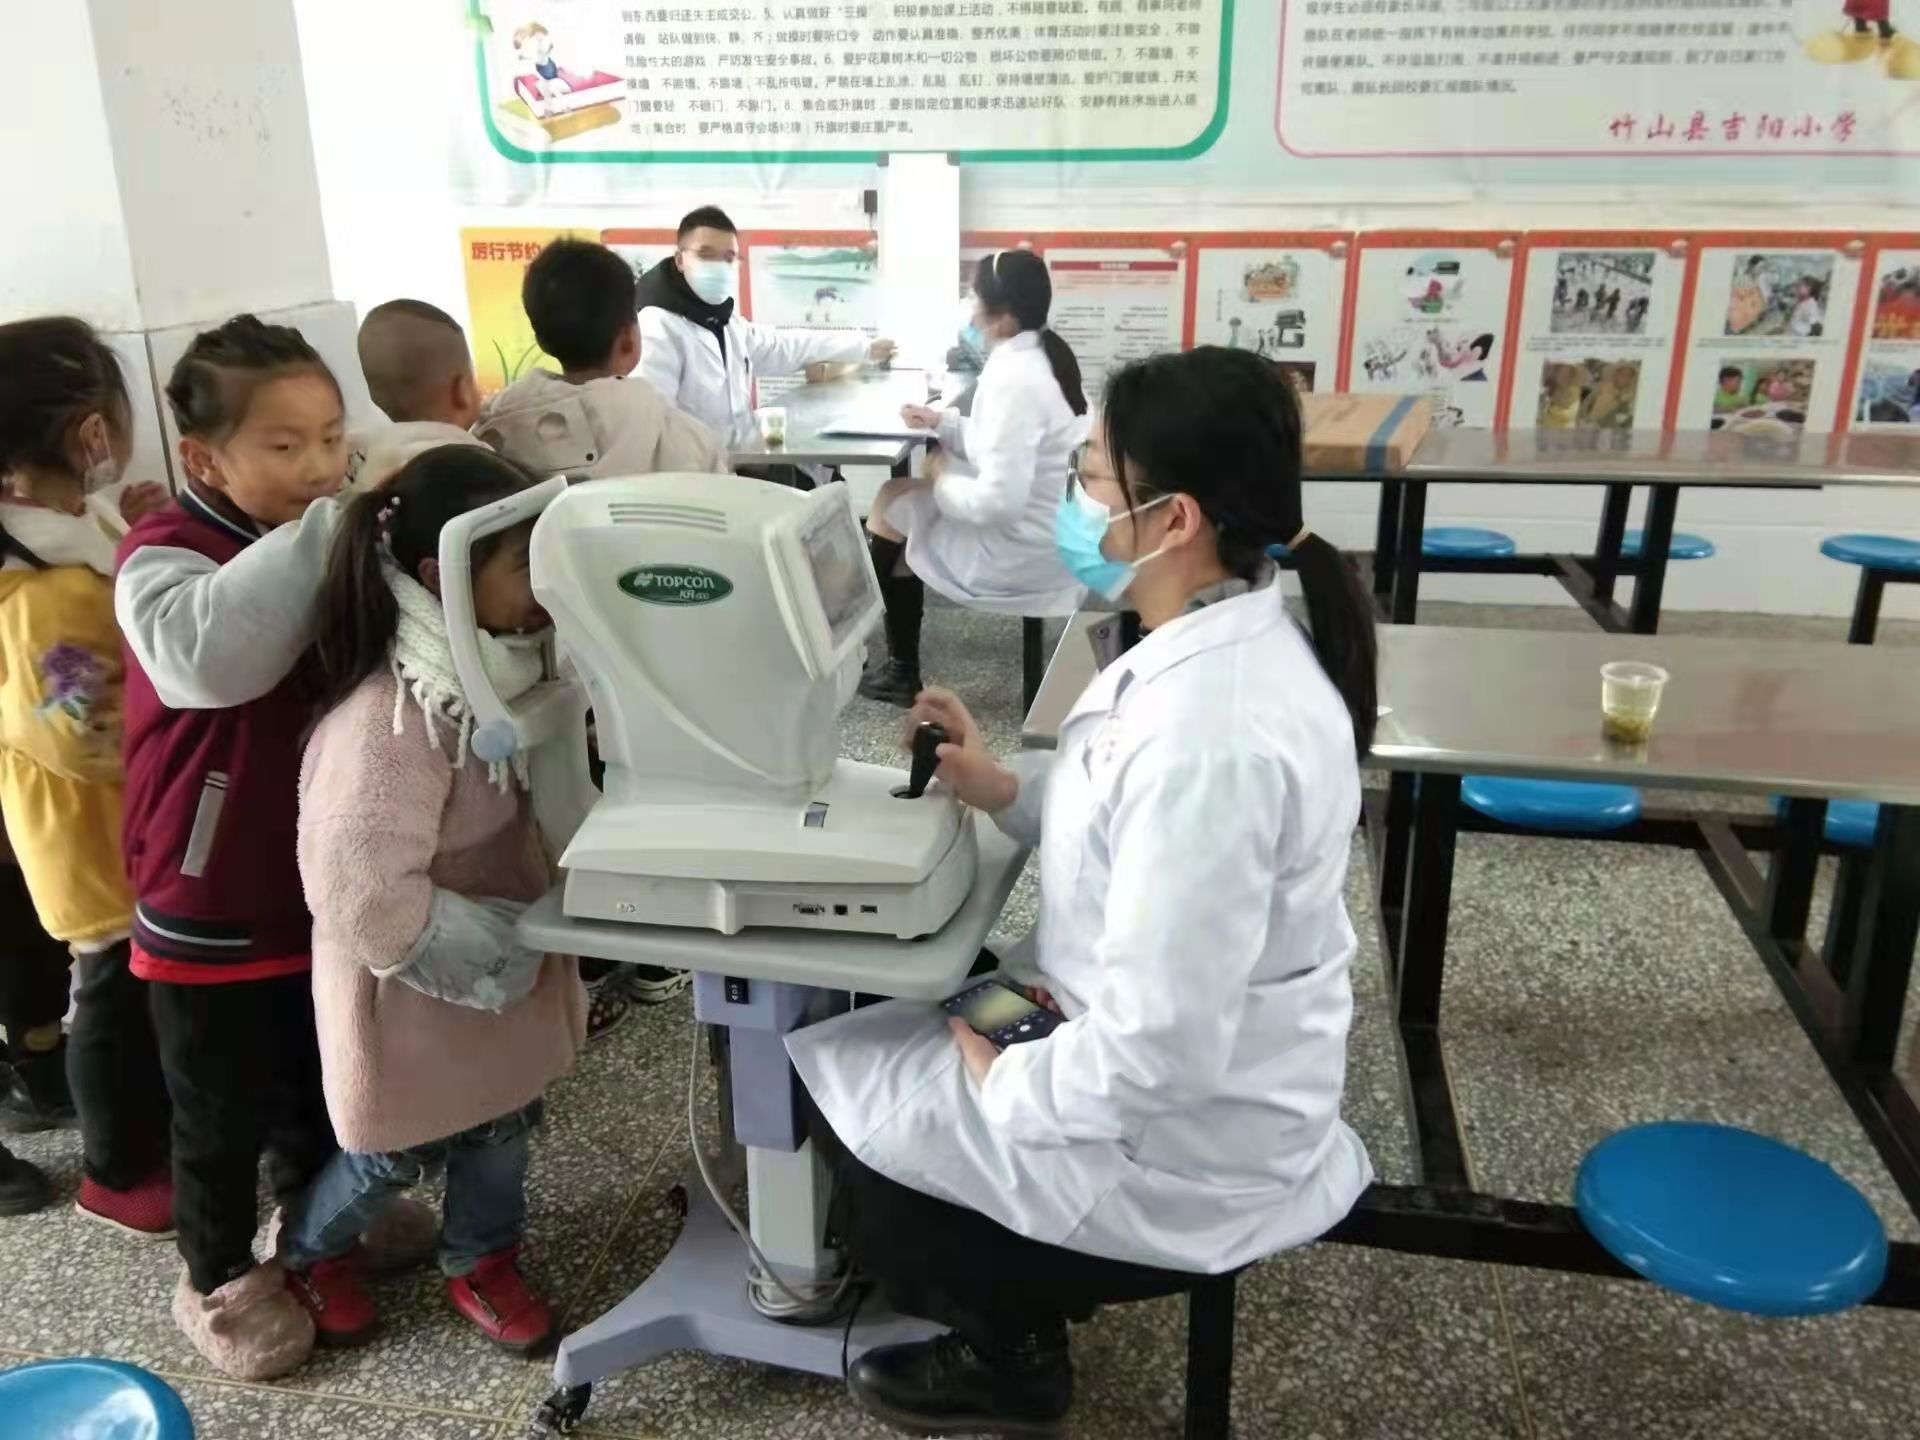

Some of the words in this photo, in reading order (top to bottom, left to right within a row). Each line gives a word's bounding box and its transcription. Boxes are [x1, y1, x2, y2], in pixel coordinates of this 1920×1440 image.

[1609, 111, 1857, 143] 竹山县吉阳小学
[472, 242, 541, 261] 厉行节约
[654, 574, 715, 589] TOPCON
